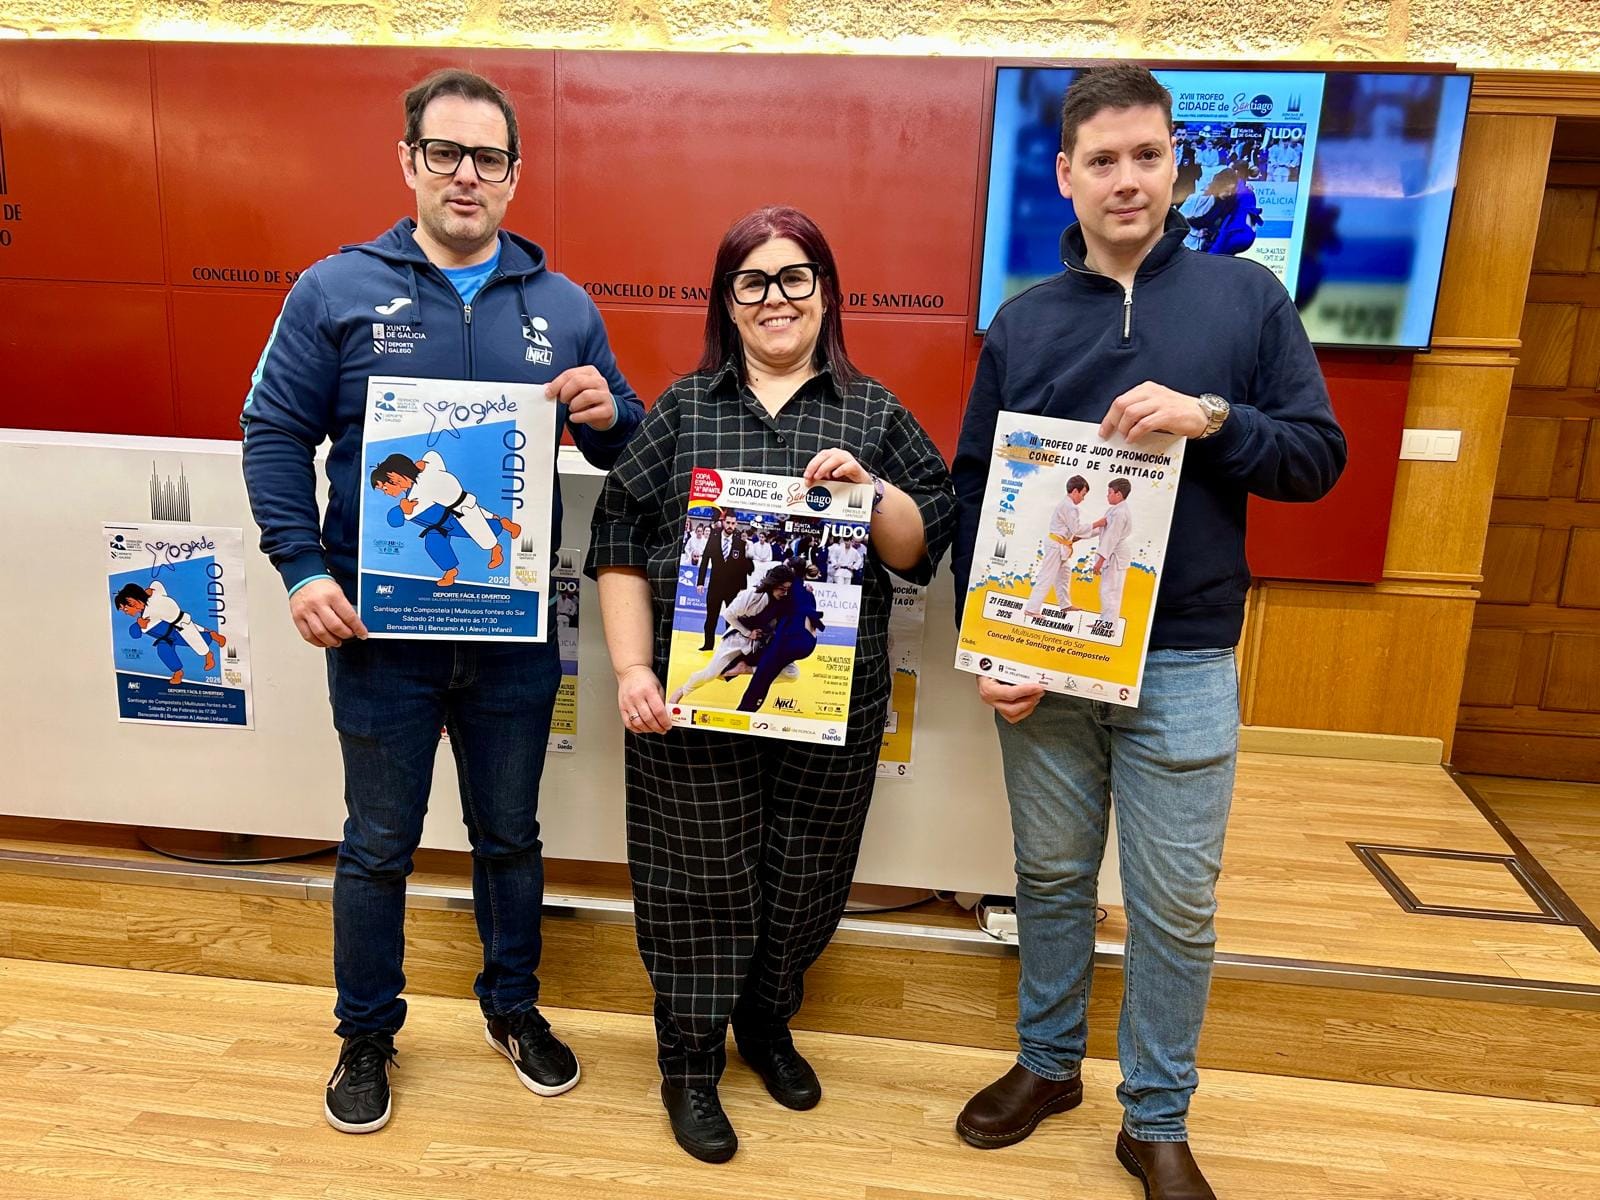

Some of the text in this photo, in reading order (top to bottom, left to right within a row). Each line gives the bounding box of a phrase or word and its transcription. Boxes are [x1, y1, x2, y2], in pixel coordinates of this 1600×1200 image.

[1196, 93, 1224, 101] TROFEO
[1178, 101, 1215, 111] CIDADE
[1218, 102, 1229, 112] de
[1259, 197, 1294, 205] GALICIA
[3, 204, 22, 221] DE
[192, 267, 260, 282] CONCELLO
[264, 270, 281, 283] DE
[583, 282, 654, 298] CONCELLO
[659, 286, 677, 299] DE
[849, 292, 867, 306] DE
[871, 293, 944, 308] SANTIAGO
[397, 332, 426, 340] GALICIA
[1029, 437, 1171, 466] III TROFEO DE JUDO PROMOCIÓN
[502, 429, 527, 509] JUDO
[1029, 451, 1164, 480] CONCELLO DE SANTIAGO
[748, 479, 777, 489] TROFEO
[728, 486, 767, 499] CIDADE
[770, 491, 783, 500] de
[787, 483, 831, 507] Santiago
[488, 576, 510, 584] 2026
[206, 563, 224, 625] JUDO
[819, 601, 858, 610] GALICIA
[997, 598, 1023, 610] FEBREIRO
[996, 609, 1013, 619] 2026
[987, 630, 1014, 642] Concello
[1015, 636, 1025, 644] de
[1025, 638, 1055, 652] Santiago
[1067, 647, 1110, 662] Compostela
[1041, 635, 1061, 645] fontes
[1074, 641, 1085, 649] Sar
[821, 733, 841, 742] Daedo
